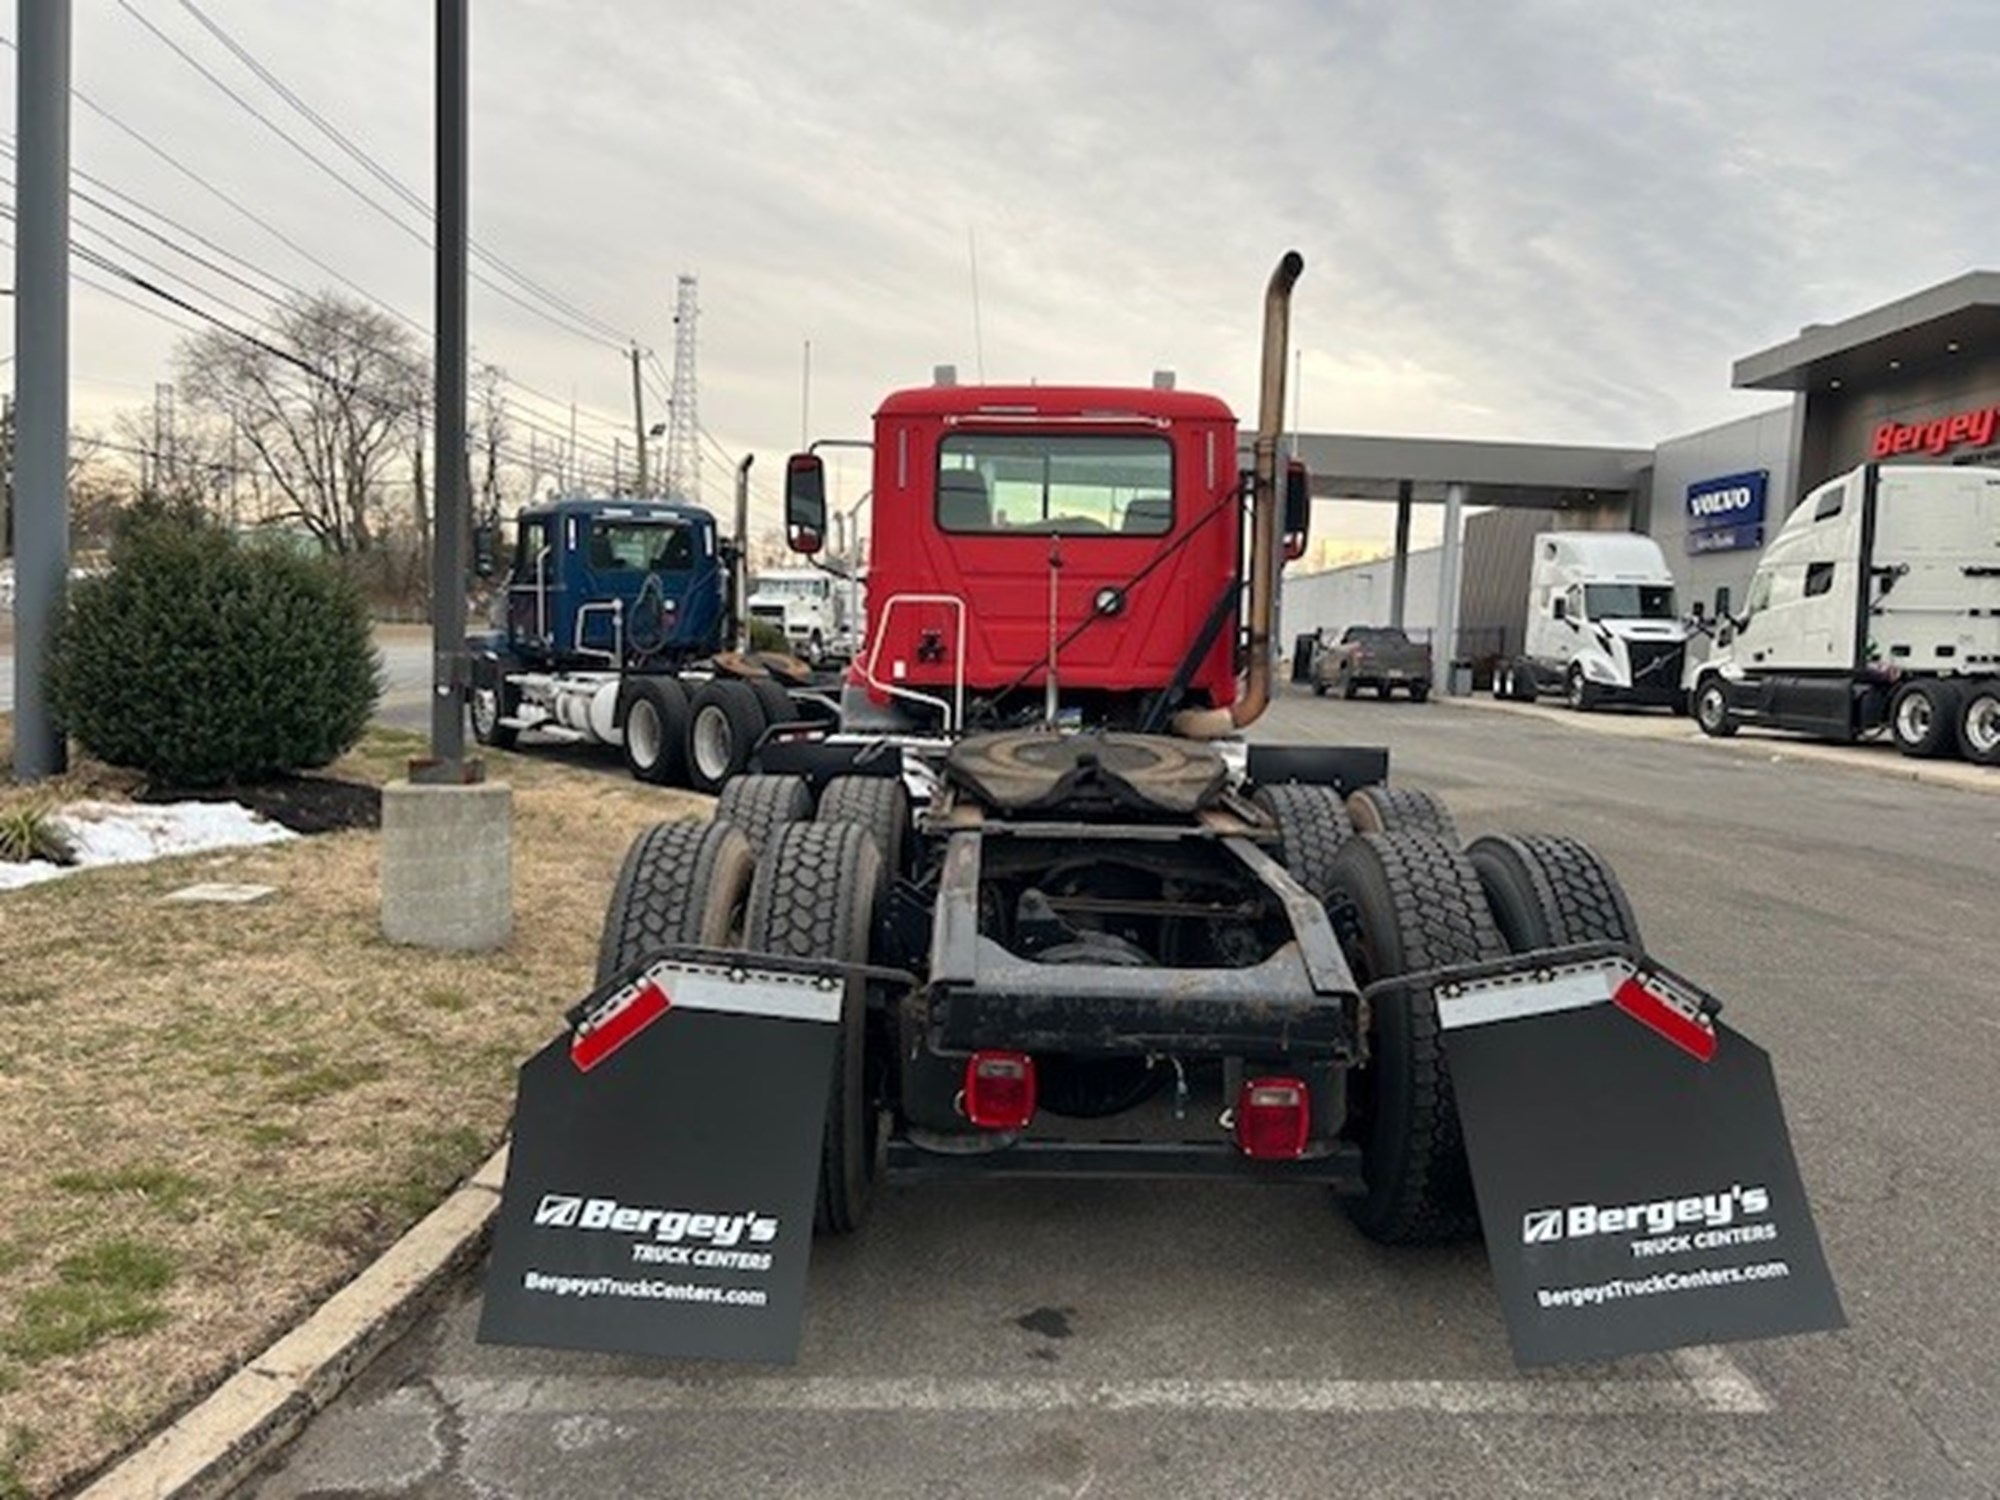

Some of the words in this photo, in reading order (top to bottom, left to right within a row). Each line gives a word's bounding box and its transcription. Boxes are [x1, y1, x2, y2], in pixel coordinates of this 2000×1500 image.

[1691, 487, 1751, 516] VOLVO
[578, 1198, 779, 1246] Bergey's
[1568, 1184, 1769, 1238] Bergey's
[632, 1244, 694, 1265] TRUCK
[692, 1250, 773, 1271] CENTERS
[1630, 1234, 1693, 1257] TRUCK
[1694, 1223, 1778, 1249] CENTERS
[524, 1271, 768, 1306] BergeysTruckCenters.com
[1537, 1261, 1790, 1307] BergeysTruckCenters.com
